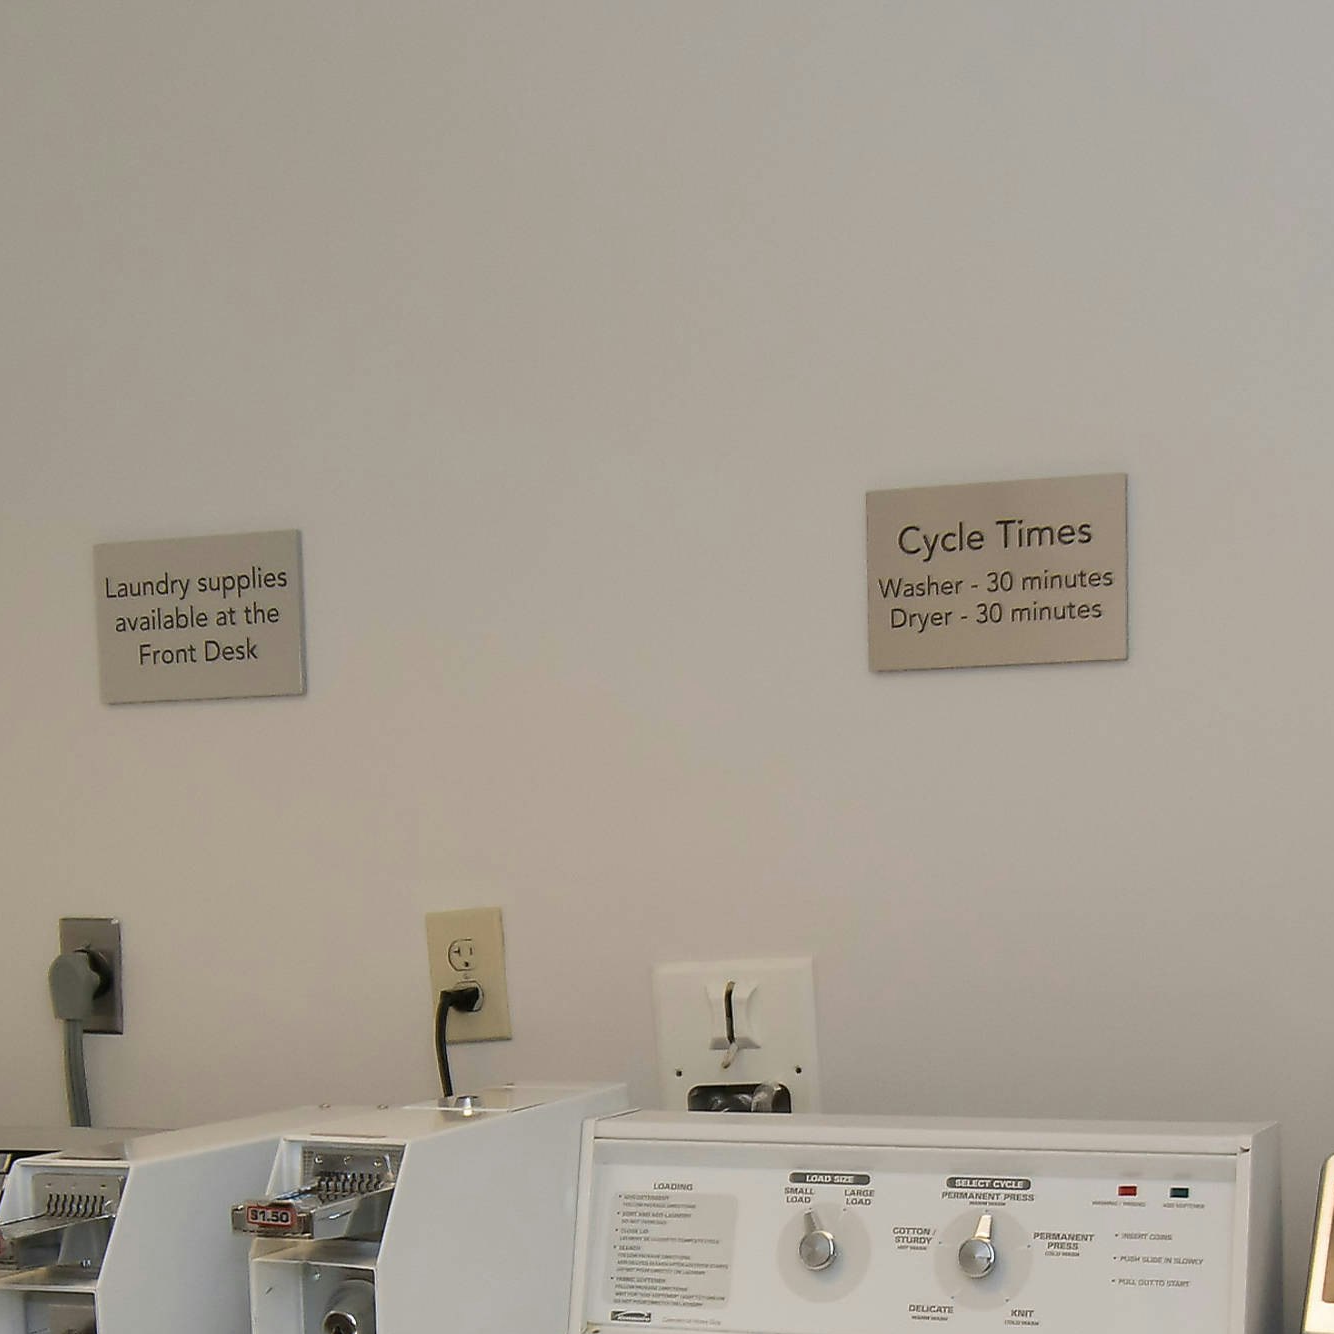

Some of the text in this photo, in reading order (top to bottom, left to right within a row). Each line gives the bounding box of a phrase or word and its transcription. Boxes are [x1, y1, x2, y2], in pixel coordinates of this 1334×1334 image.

[898, 520, 1092, 562] Cycle Times
[105, 566, 287, 600] Laundry supplies
[878, 575, 963, 598] Washer
[986, 571, 1013, 592] 30
[1022, 569, 1114, 591] minutes
[115, 602, 279, 632] available at the
[891, 608, 953, 633] Dryer
[976, 603, 1002, 624] 30
[1011, 601, 1102, 623] minutes
[139, 637, 258, 665] Front Desk
[806, 1174, 854, 1184] LOAD SIZE
[653, 1183, 693, 1191] LOADING
[955, 1179, 1024, 1189] SELECT CYCLE
[784, 1187, 815, 1195] SMALL
[844, 1189, 875, 1197] LARGE
[786, 1196, 811, 1204] LOAD
[942, 1191, 1034, 1201] PERMANENT PRESS
[846, 1198, 872, 1206] LOAD
[250, 1205, 289, 1222] $1.50
[893, 1227, 930, 1235] COTTON
[895, 1236, 932, 1244] STURDY
[1034, 1232, 1094, 1241] PERMANENT
[1047, 1242, 1078, 1250] PRESS
[909, 1304, 954, 1313] DELICATE
[1011, 1309, 1035, 1318] KNIT
